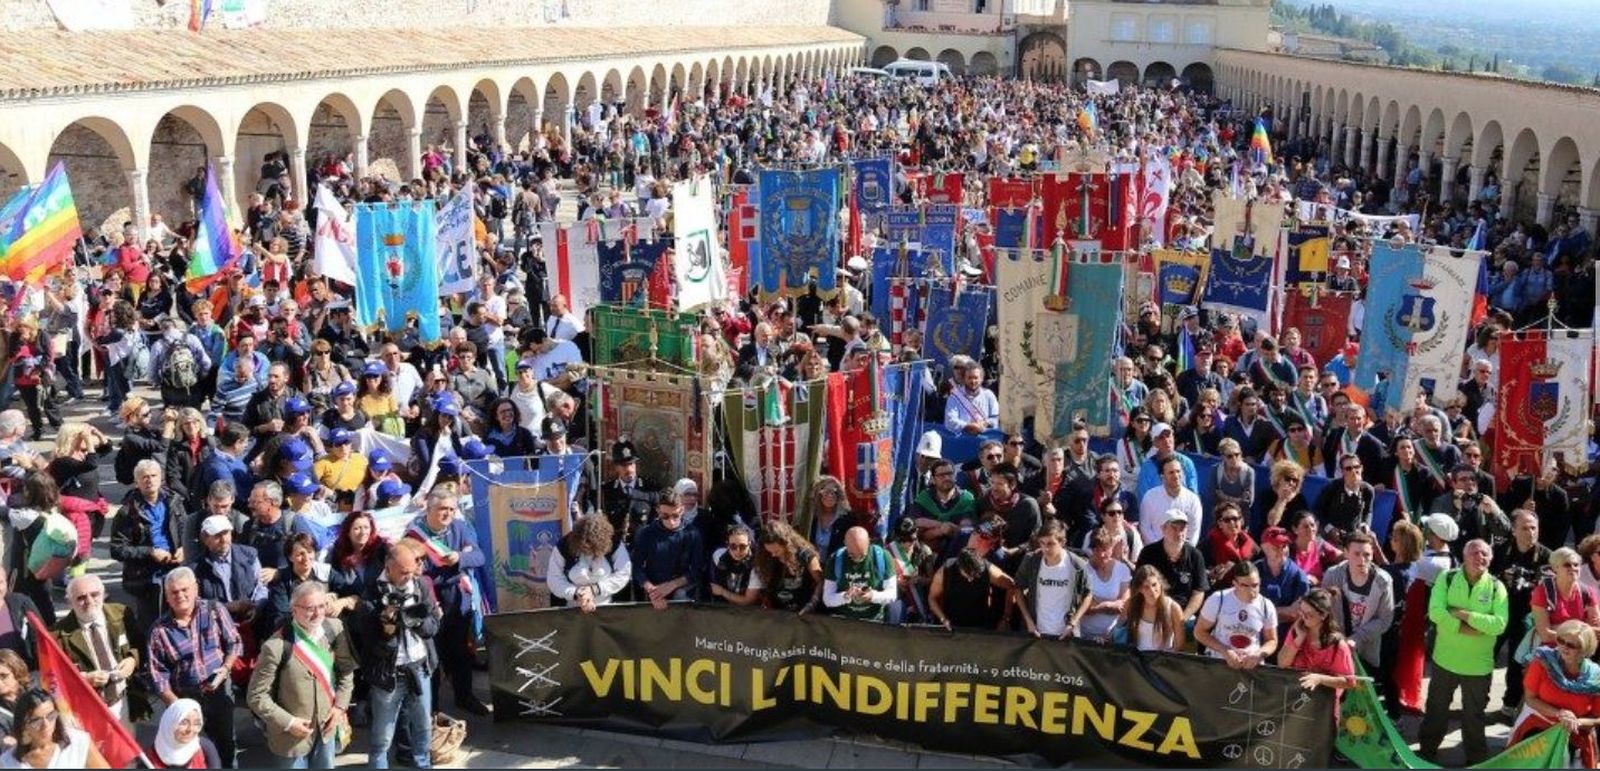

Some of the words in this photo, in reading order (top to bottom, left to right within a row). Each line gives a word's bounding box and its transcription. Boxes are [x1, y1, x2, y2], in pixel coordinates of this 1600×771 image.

[1003, 273, 1048, 304] COMUNE
[695, 636, 734, 653] Marcia
[737, 641, 806, 663] PerugiAssisi
[809, 646, 837, 661] della
[840, 655, 870, 667] pace
[873, 661, 881, 669] e
[884, 659, 914, 673] della
[918, 659, 979, 675] fraternità
[991, 668, 998, 678] 9
[1002, 666, 1050, 681] ottobre
[1054, 673, 1084, 686] 2016
[580, 657, 732, 707] VINCI
[752, 664, 1201, 759] L'INDIFFERENZA
